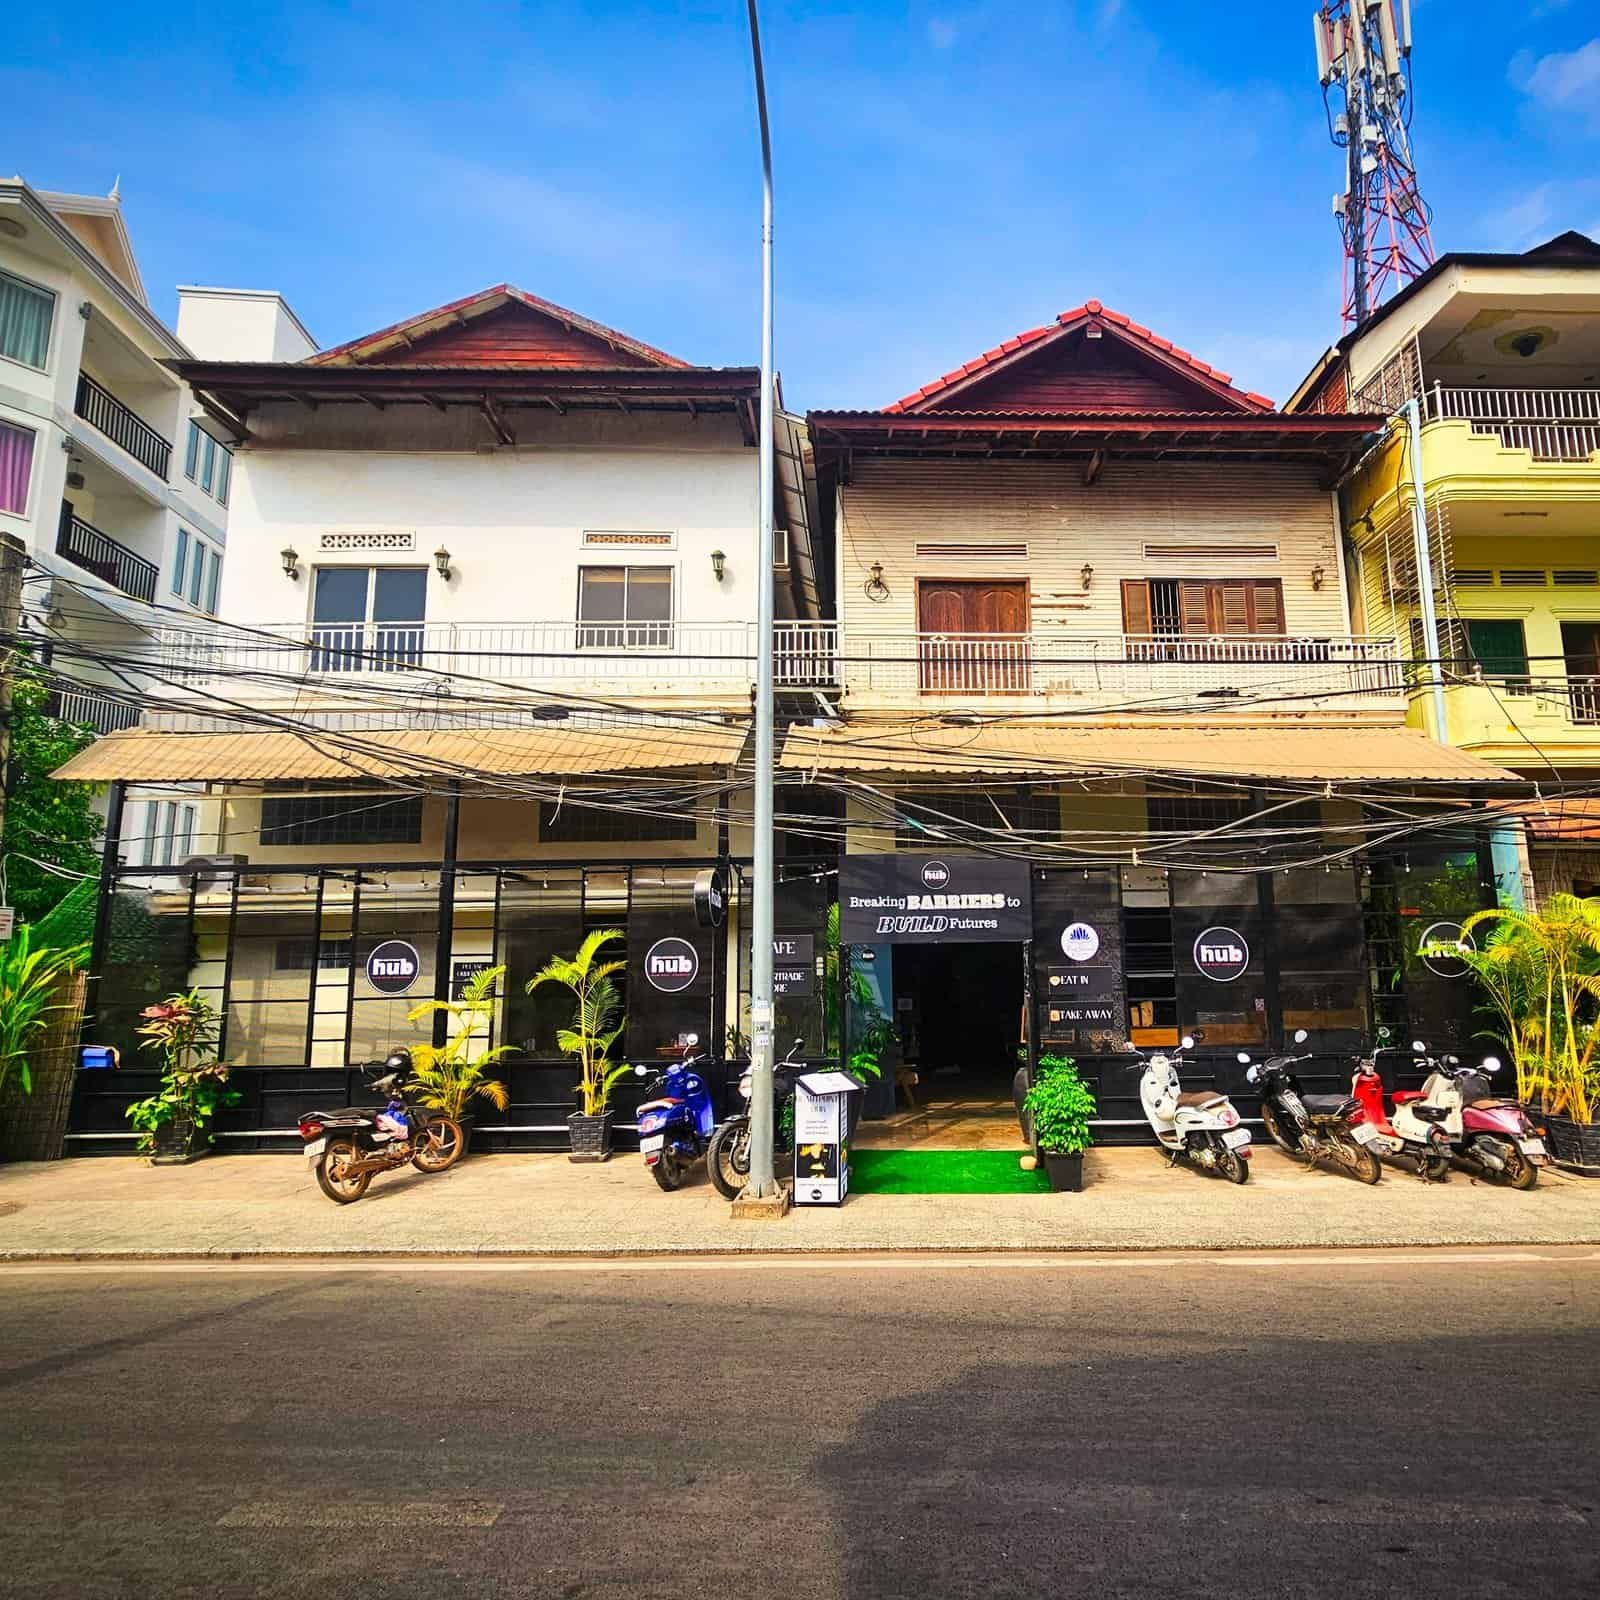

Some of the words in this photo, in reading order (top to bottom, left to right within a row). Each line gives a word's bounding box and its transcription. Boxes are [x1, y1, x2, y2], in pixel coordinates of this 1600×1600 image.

[924, 870, 947, 880] hub
[849, 895, 906, 910] Breaking
[906, 893, 1006, 911] BARRIERS
[1007, 896, 1021, 908] to
[876, 915, 949, 934] BUILD
[949, 918, 998, 930] Futures
[1200, 944, 1243, 963] hub
[372, 958, 414, 976] hub
[650, 954, 693, 974] hub
[1061, 975, 1078, 985] EAT
[1080, 975, 1089, 985] IN
[1061, 1009, 1082, 1020] TAKE
[1085, 1009, 1113, 1020] AWAY
